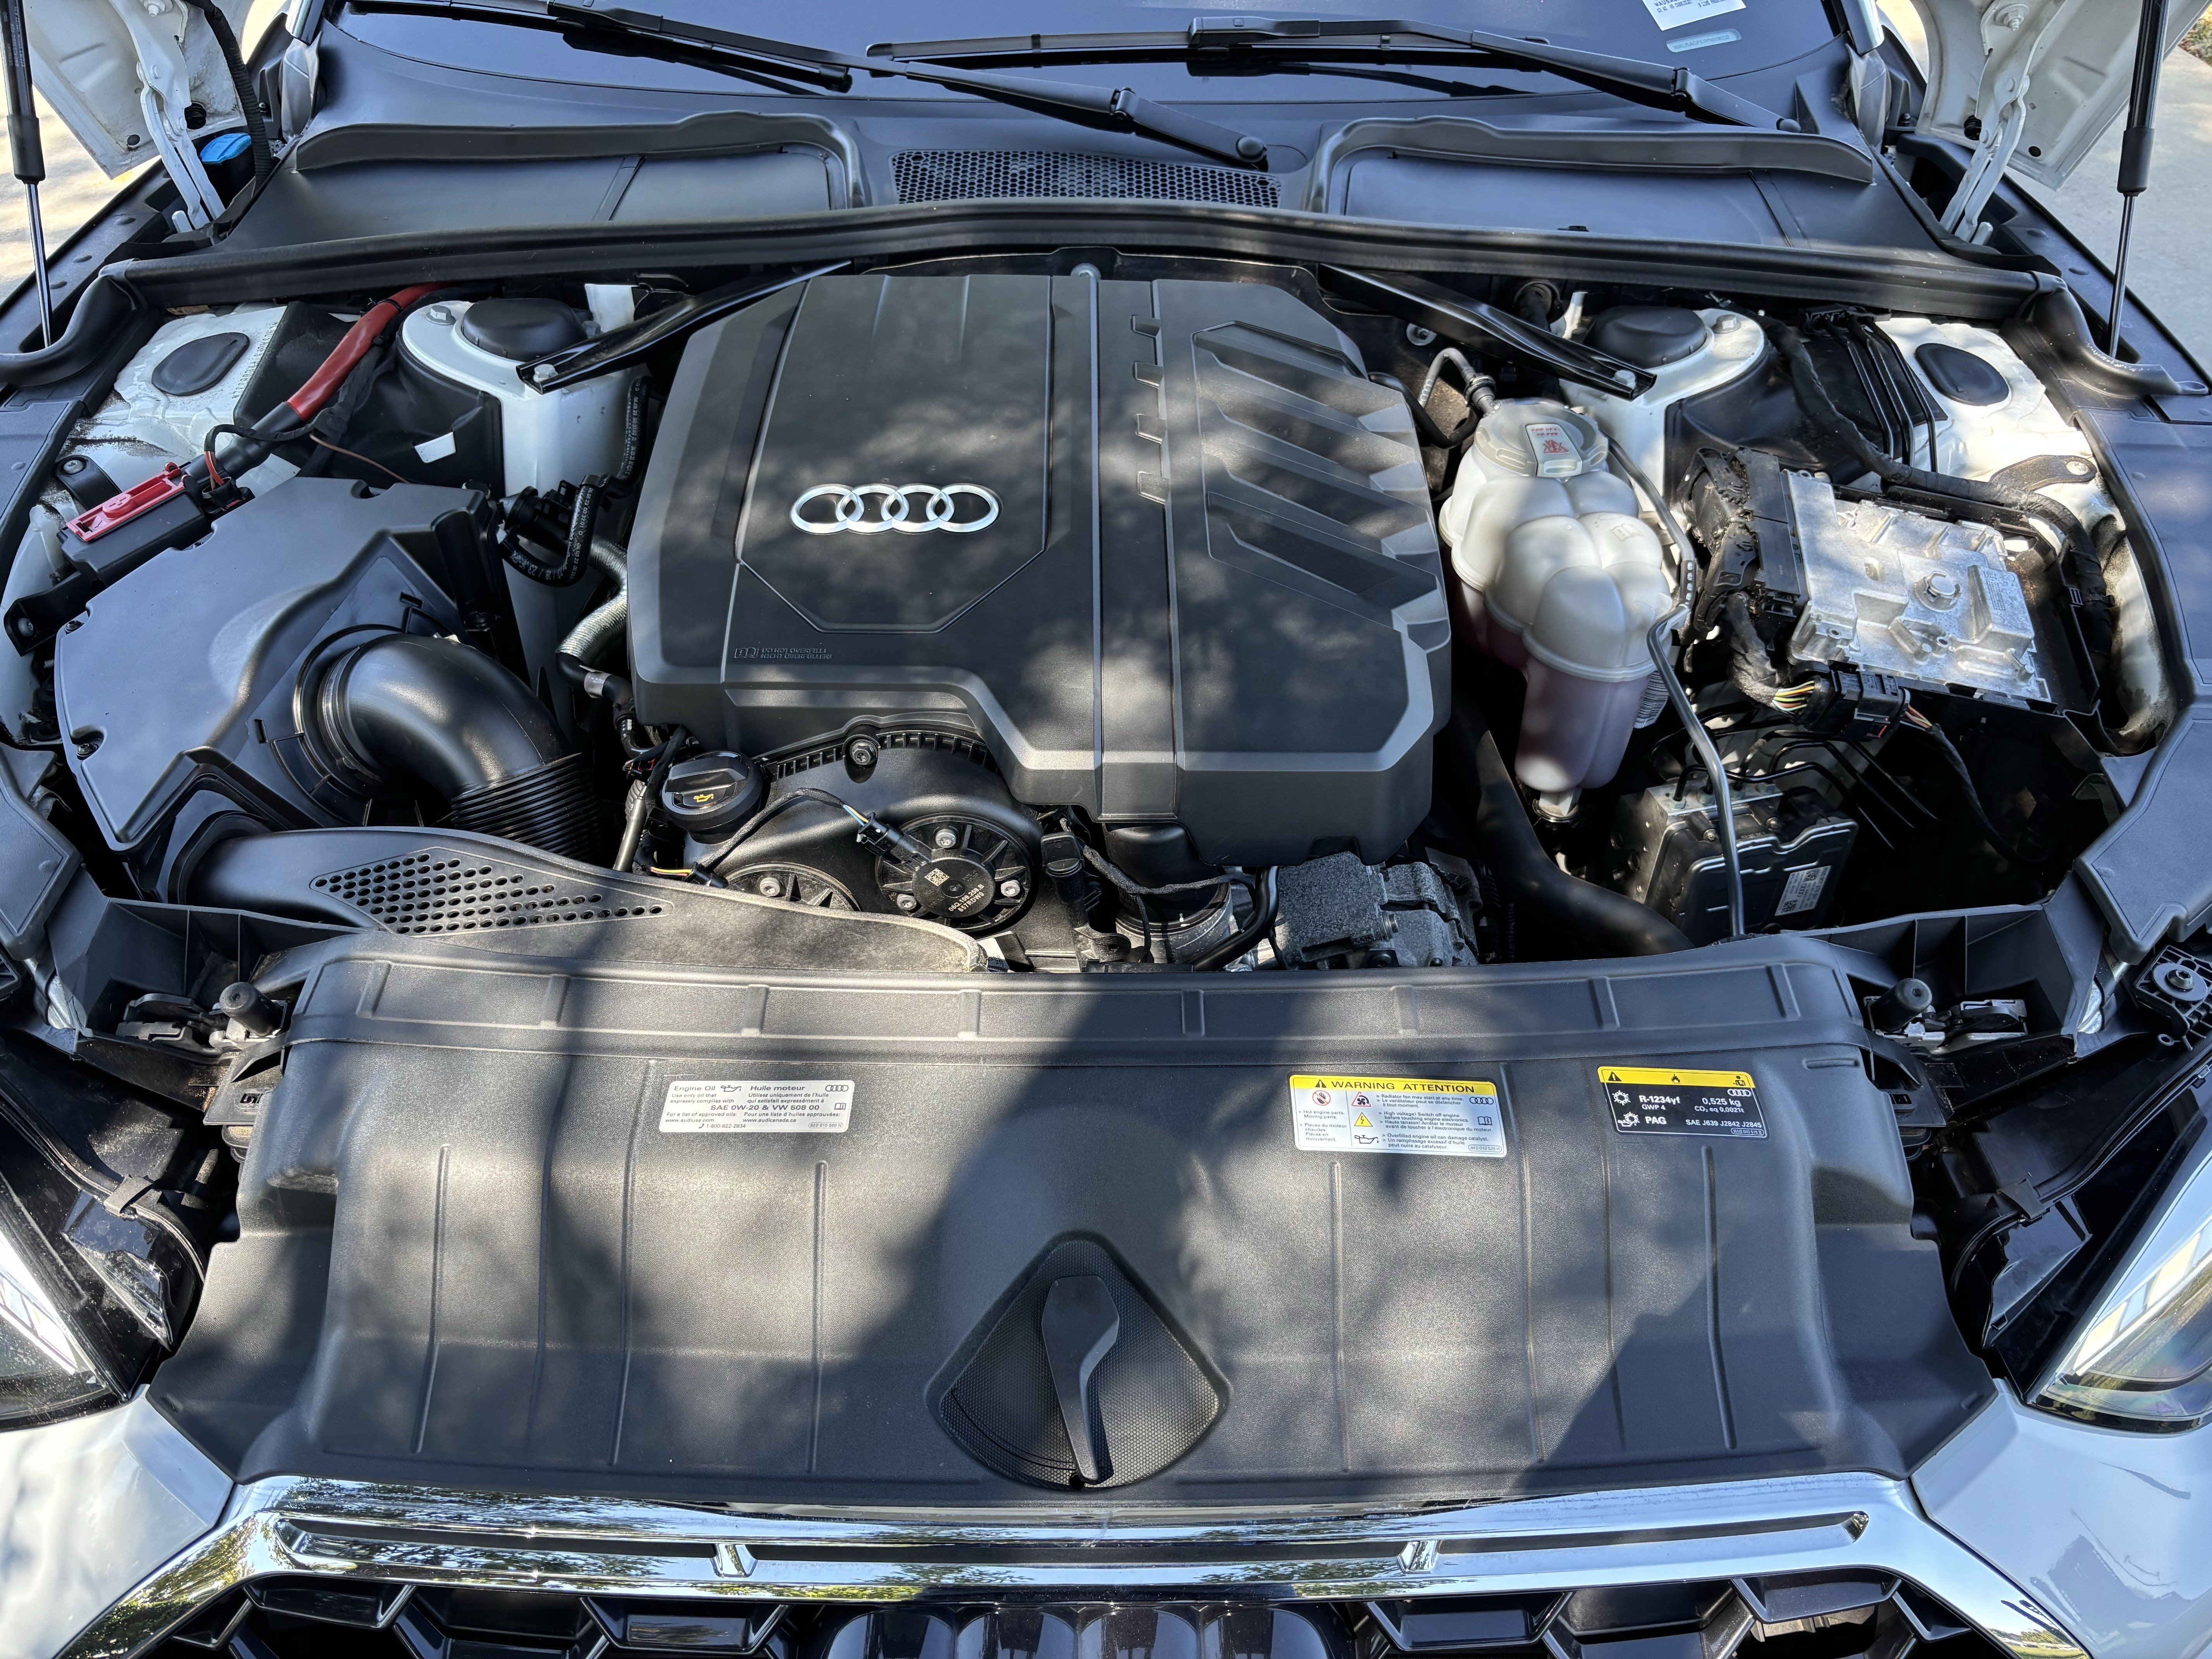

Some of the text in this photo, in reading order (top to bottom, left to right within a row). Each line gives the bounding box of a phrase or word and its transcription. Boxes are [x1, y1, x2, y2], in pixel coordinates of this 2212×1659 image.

[1331, 1081, 1475, 1093] WARNING ATTENTION
[1638, 1095, 1680, 1105] R-1234yf
[1702, 1097, 1741, 1107] 0,525 kg
[1645, 1116, 1667, 1124] PAG
